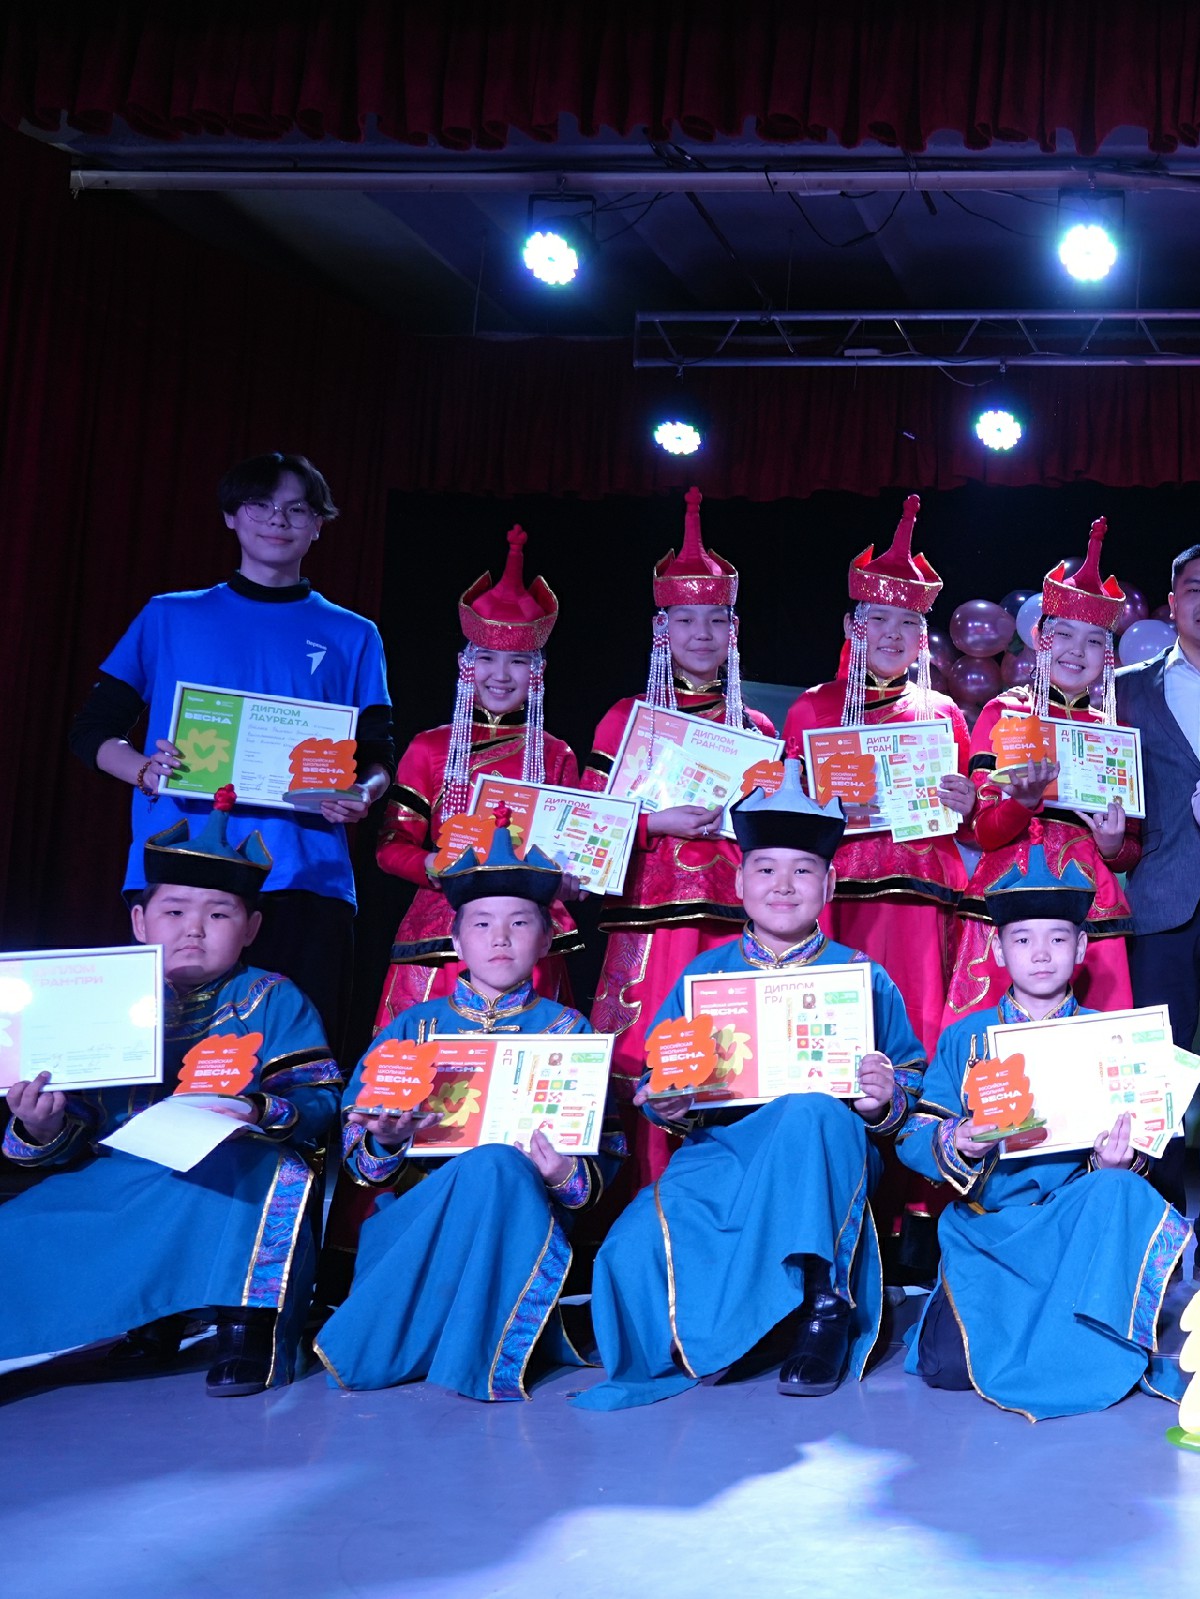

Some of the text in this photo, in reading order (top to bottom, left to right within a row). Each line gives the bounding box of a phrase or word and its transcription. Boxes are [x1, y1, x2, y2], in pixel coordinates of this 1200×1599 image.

[250, 704, 301, 717] ДИПЛОМ
[185, 712, 232, 724] ВЕСНА
[249, 713, 309, 727] ЛАУРЕАТА
[693, 729, 735, 746] ДИПЛОМ
[690, 738, 738, 756] ГРАН-ПРИ
[1002, 742, 1037, 751] ВЕСНА
[303, 767, 346, 775] ВЕСНА
[700, 1007, 750, 1017] ВЕСНА
[660, 1051, 706, 1064] ВЕСНА
[194, 1068, 241, 1077] ВЕСНА
[376, 1075, 422, 1084] ВЕСНА
[980, 1089, 1023, 1105] ВЕСНА
